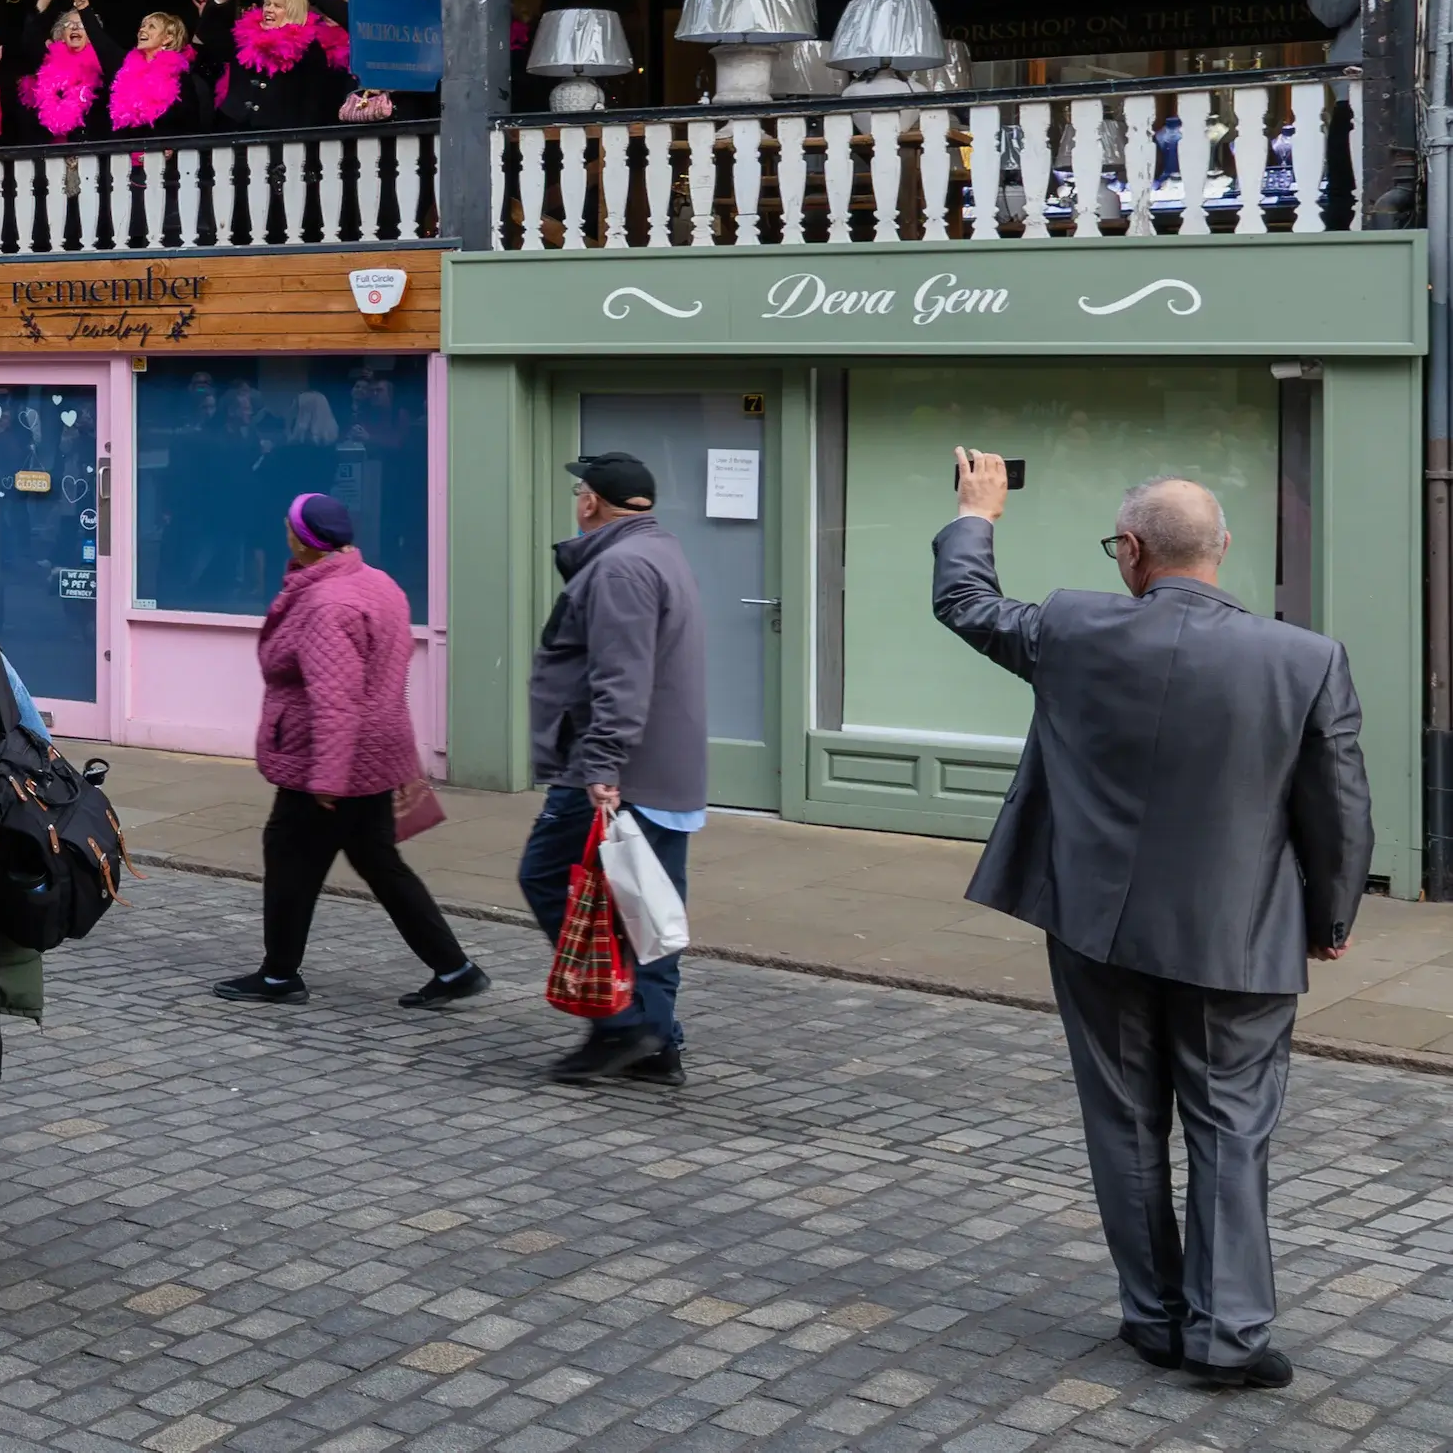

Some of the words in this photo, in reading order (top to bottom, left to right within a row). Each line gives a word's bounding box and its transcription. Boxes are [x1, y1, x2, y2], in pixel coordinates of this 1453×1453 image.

[356, 22, 410, 43] NICHOLS
[412, 28, 422, 43] &
[947, 16, 1077, 42] ORKSHOP
[1085, 14, 1129, 34] ON
[1142, 9, 1196, 30] THE
[12, 266, 208, 305] re:member
[355, 275, 370, 283] Full
[372, 274, 394, 283] Circle
[761, 273, 896, 318] Deva
[912, 273, 1010, 325] Gem
[66, 311, 153, 346] Jewelry
[748, 396, 758, 410] 7
[16, 479, 48, 489] CLOSED
[71, 580, 87, 588] PET
